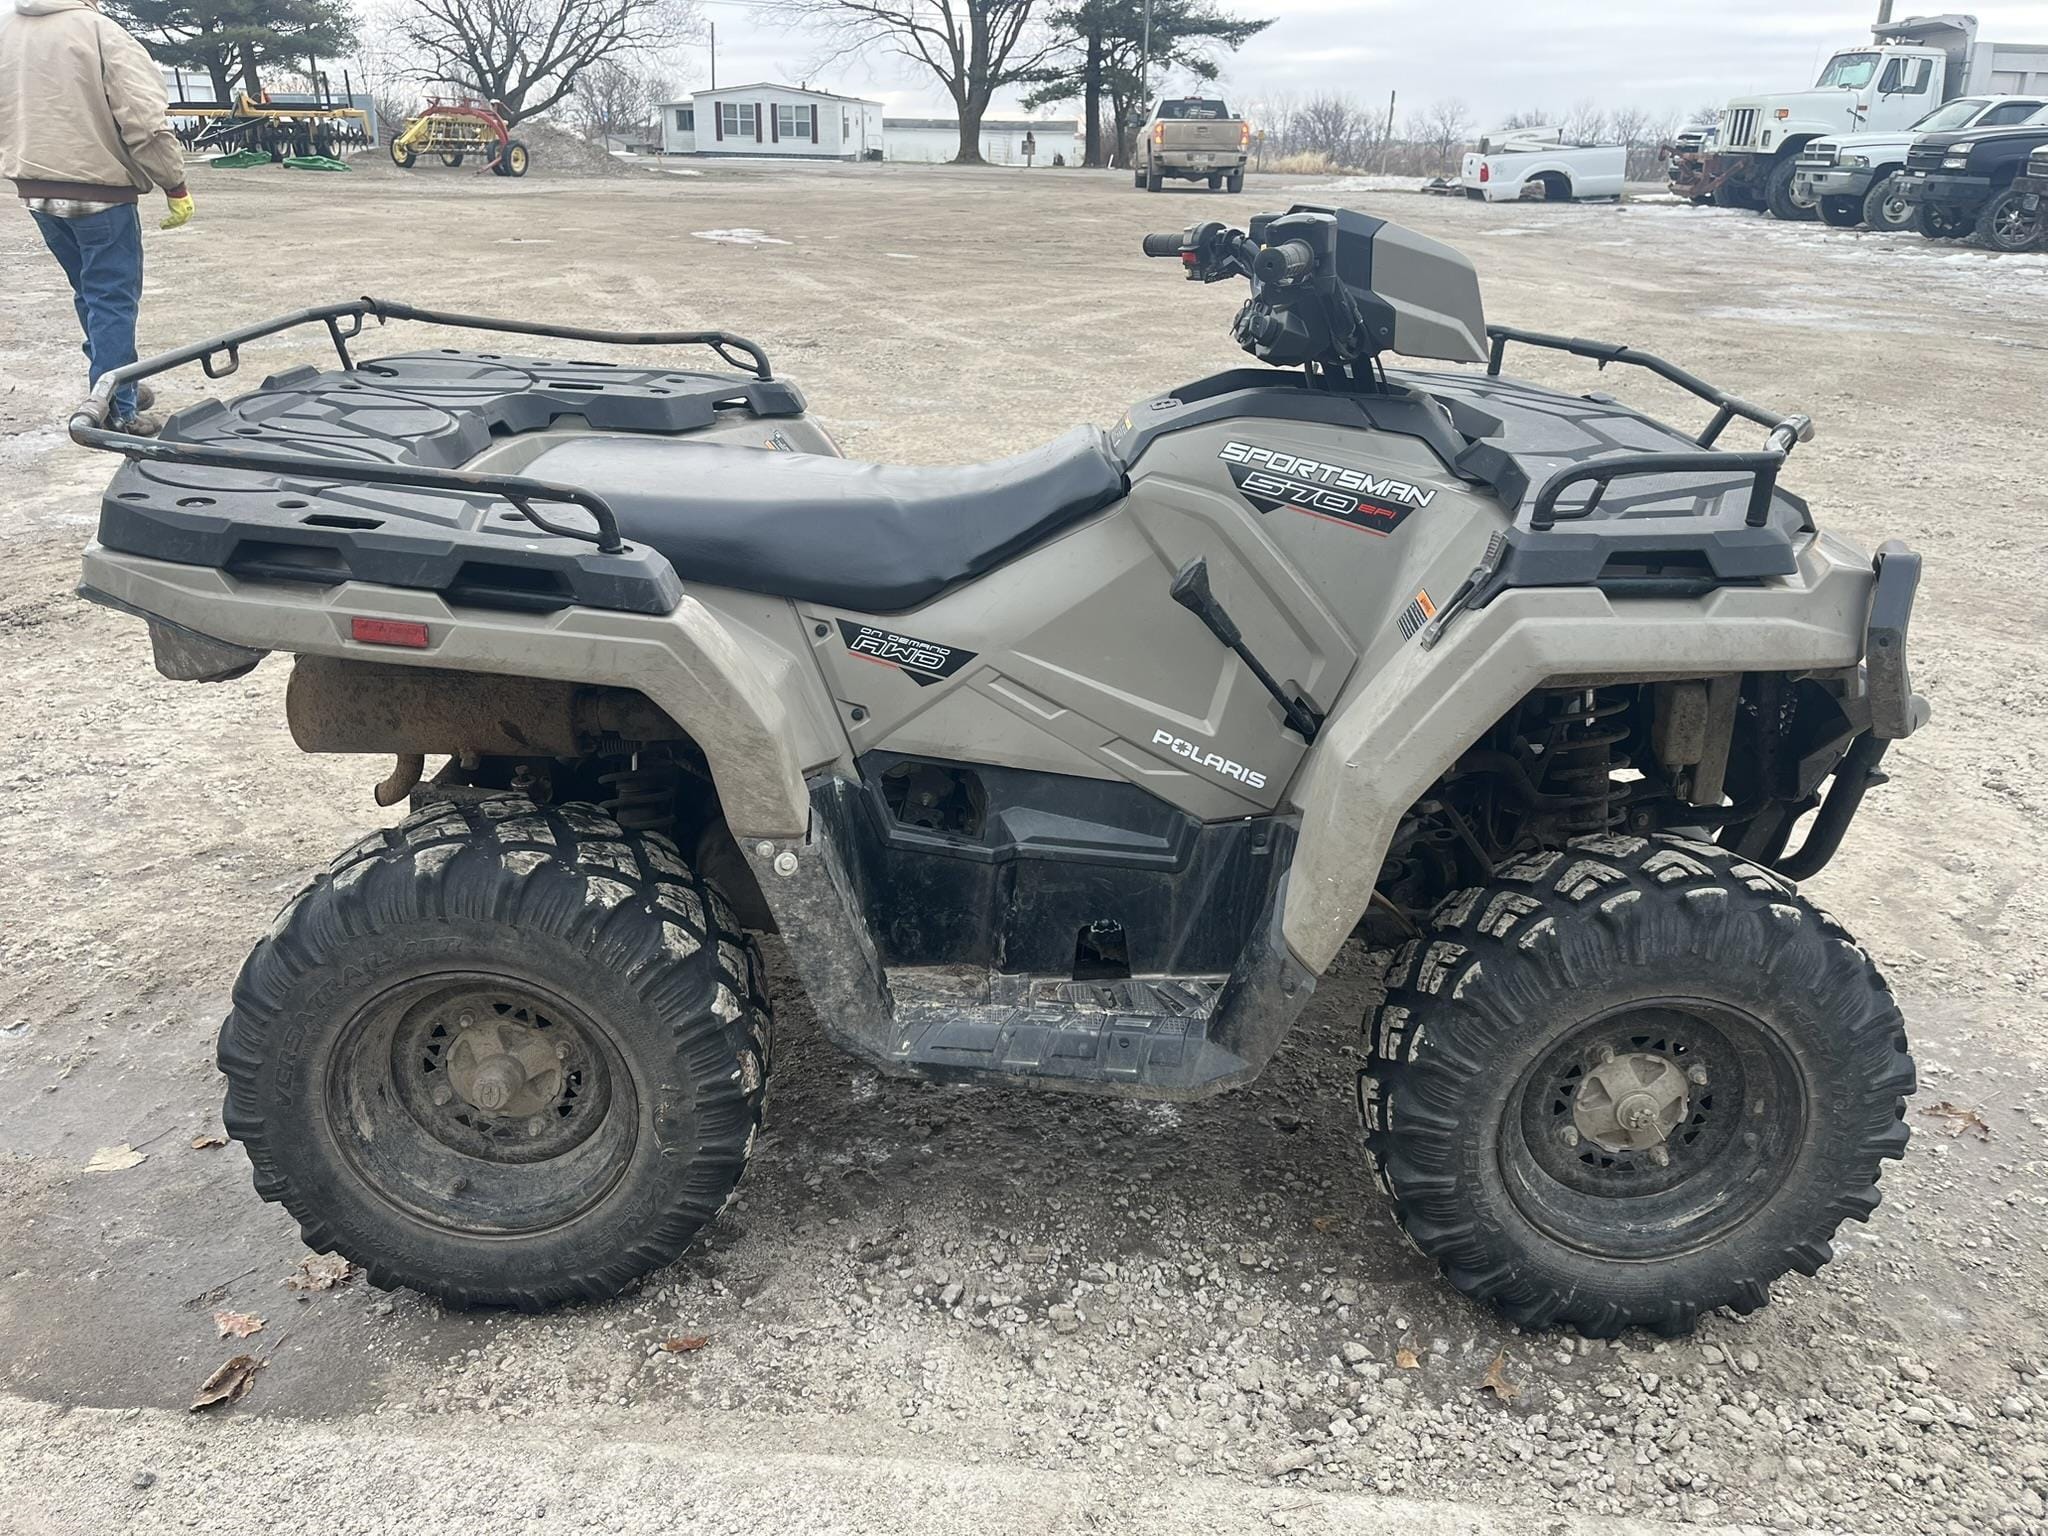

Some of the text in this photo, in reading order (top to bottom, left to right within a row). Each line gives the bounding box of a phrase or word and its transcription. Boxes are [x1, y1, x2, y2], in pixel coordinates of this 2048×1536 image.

[1219, 441, 1437, 507] SPORTSMAN
[1241, 471, 1358, 514] 570
[850, 634, 946, 670] AWD
[860, 627, 950, 656] ON DEMAND
[1151, 728, 1267, 789] POLARIS
